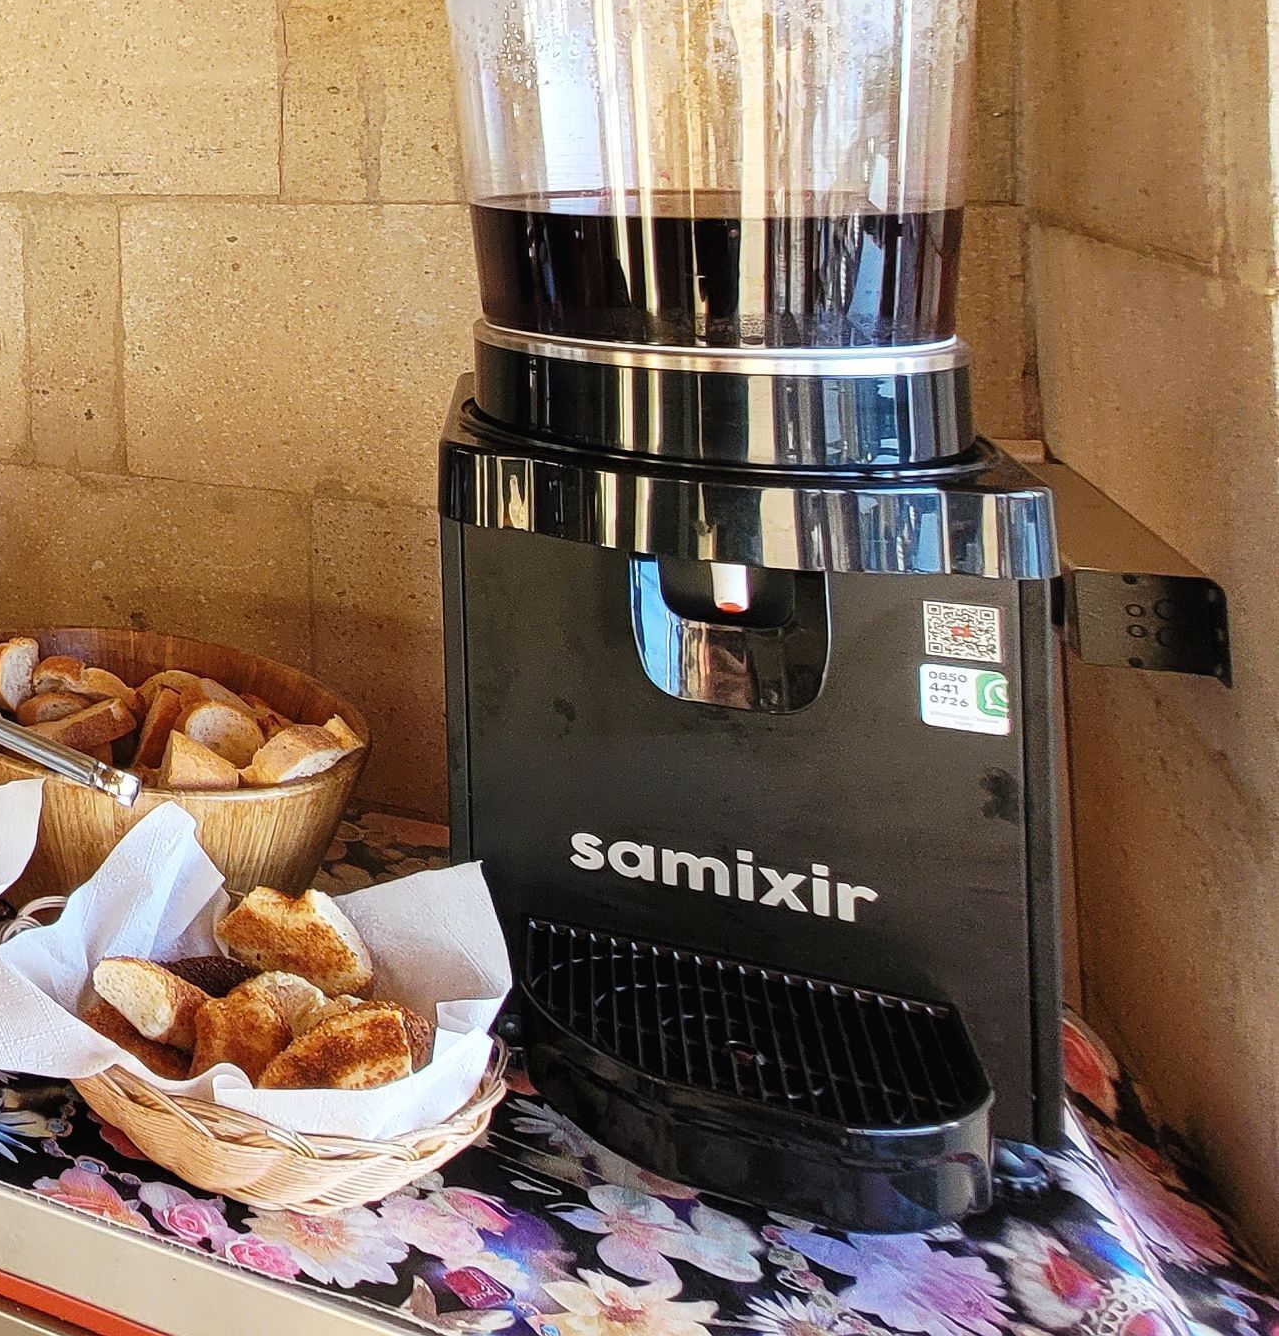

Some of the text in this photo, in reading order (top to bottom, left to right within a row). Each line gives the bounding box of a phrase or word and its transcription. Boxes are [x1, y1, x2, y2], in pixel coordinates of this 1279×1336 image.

[928, 670, 967, 683] 0850
[929, 682, 960, 695] 441
[929, 694, 969, 707] 0726
[569, 832, 879, 922] samixir
